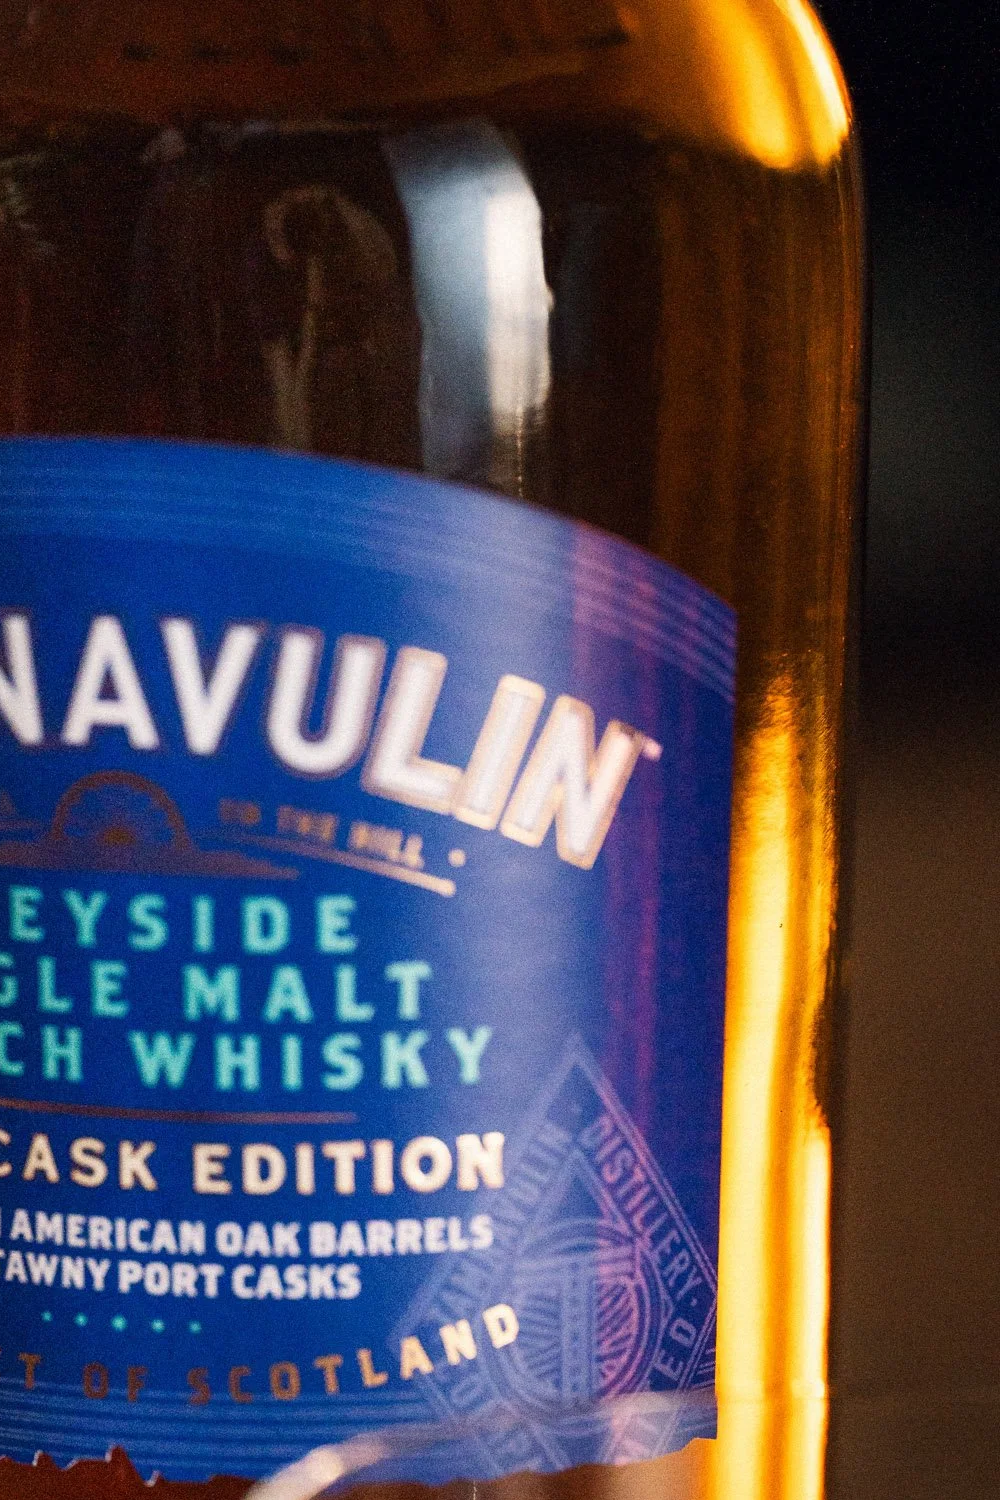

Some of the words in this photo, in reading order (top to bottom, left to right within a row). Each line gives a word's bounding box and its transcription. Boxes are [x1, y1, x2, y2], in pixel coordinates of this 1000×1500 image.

[182, 959, 433, 1023] MALT
[128, 1024, 493, 1091] WHISKY
[192, 1130, 506, 1196] EDITION
[9, 1208, 207, 1258] AMERICAN
[215, 1220, 302, 1257] OAK
[308, 1213, 495, 1258] BARRELS
[117, 1259, 225, 1299] PORT
[231, 1263, 362, 1300] CASKS
[81, 1360, 150, 1404] OF
[186, 1303, 520, 1406] SCOTLAND
